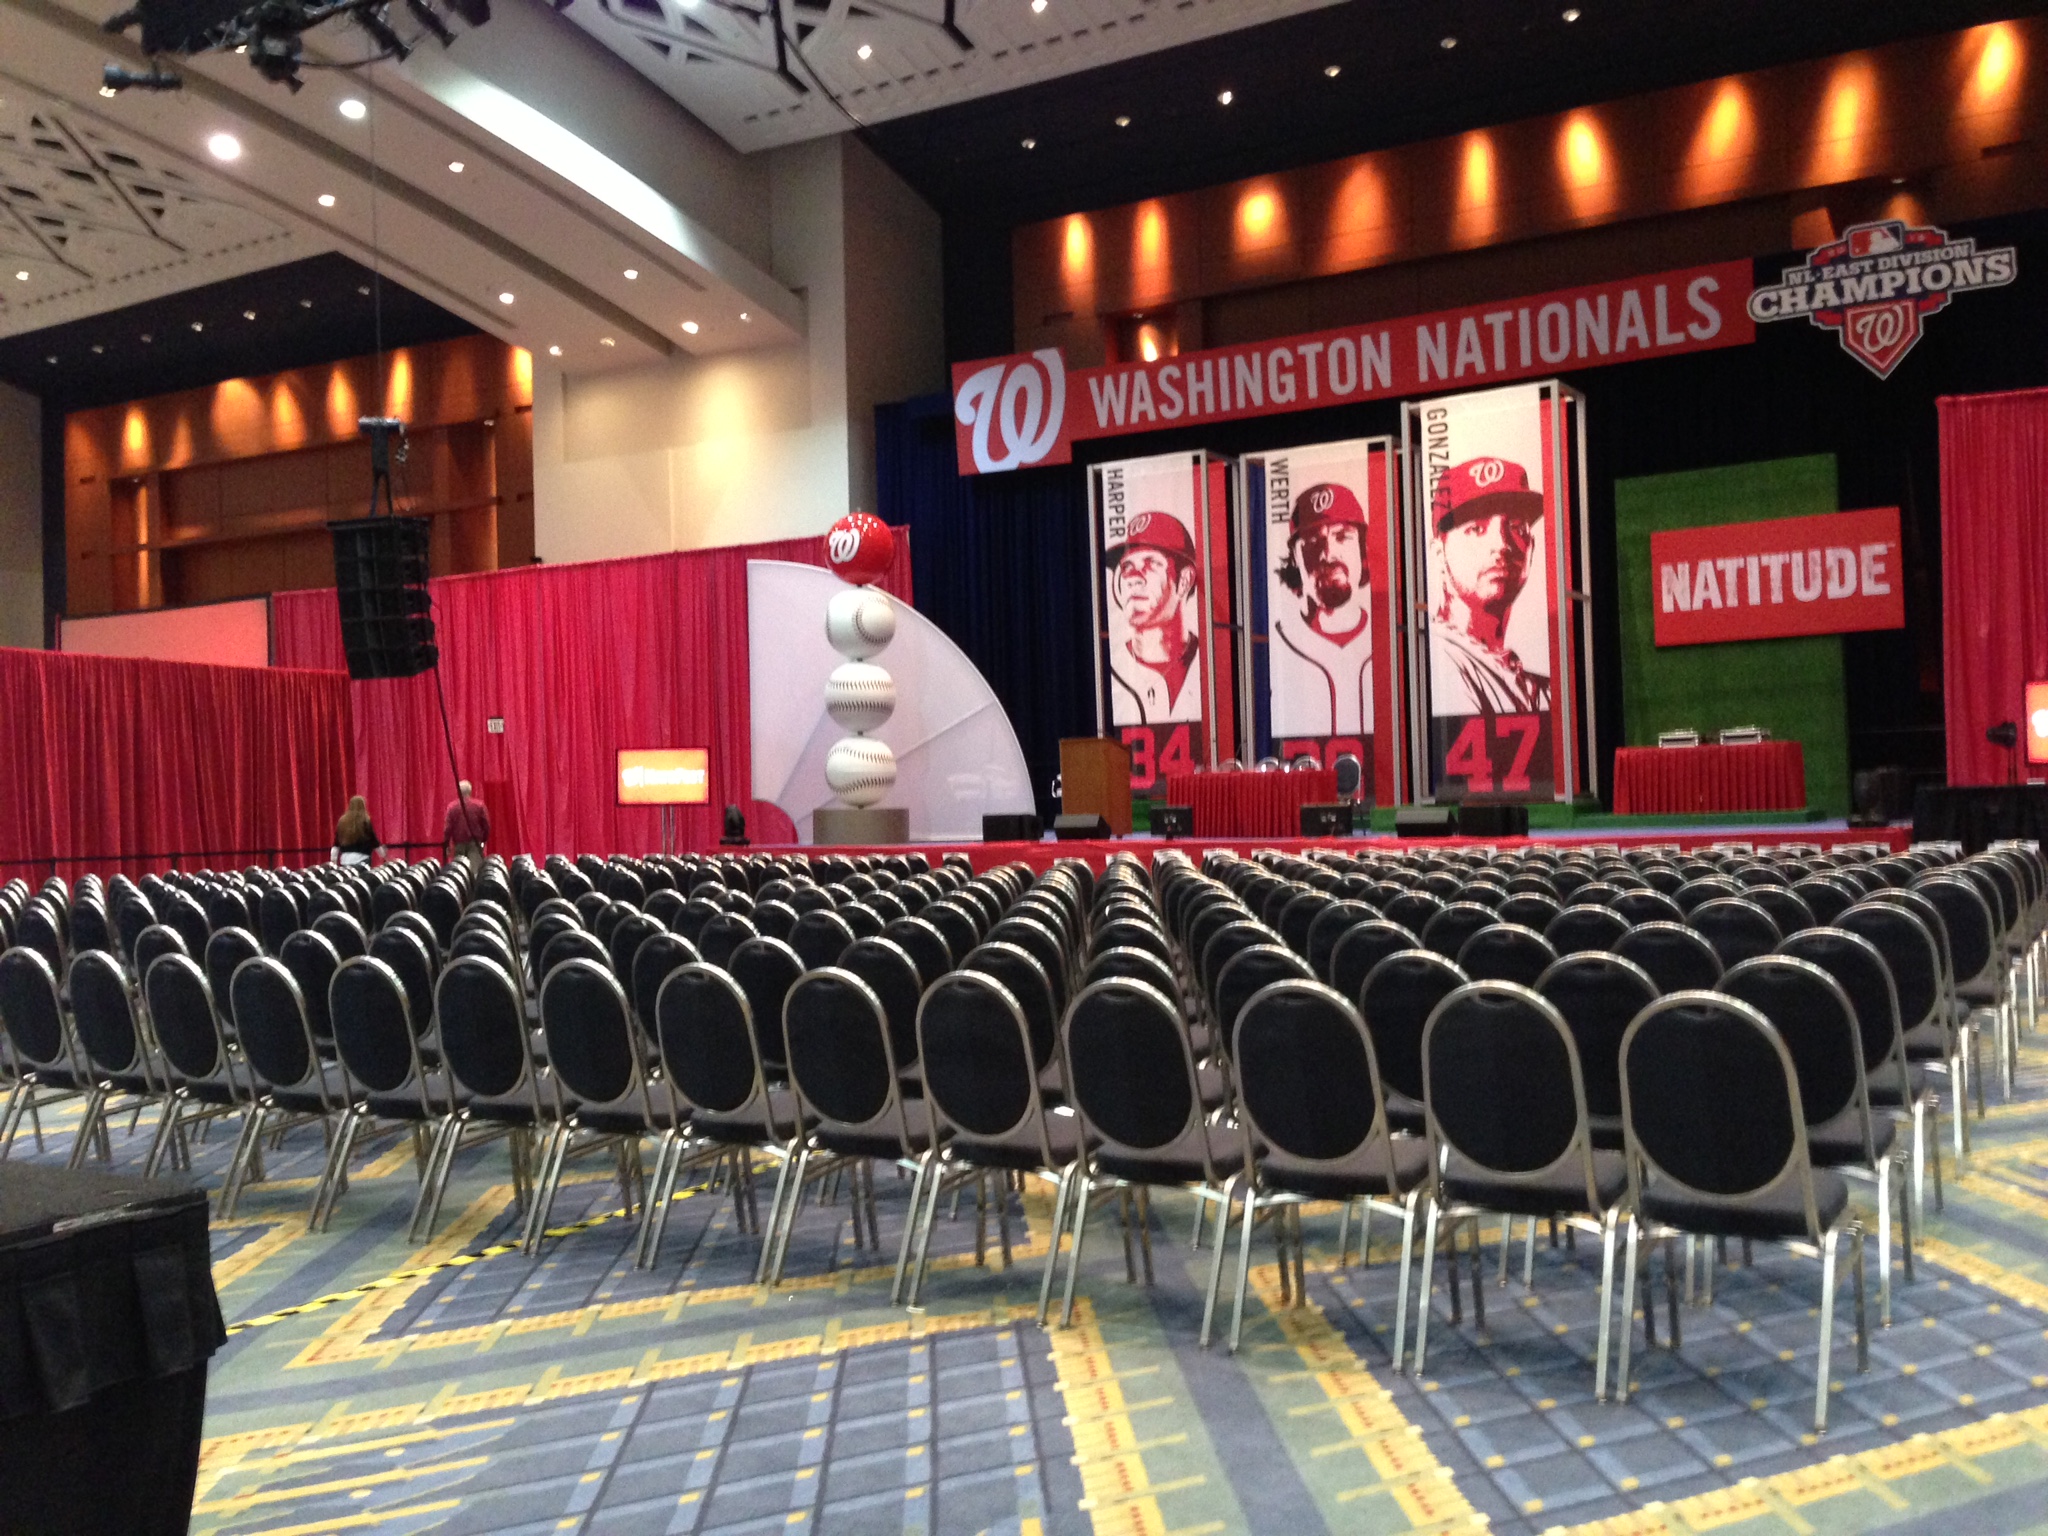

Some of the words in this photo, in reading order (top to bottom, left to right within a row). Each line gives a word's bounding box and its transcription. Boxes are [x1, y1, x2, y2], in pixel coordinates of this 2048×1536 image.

[1752, 253, 2012, 318] CHAMPIONS
[1878, 244, 1970, 270] DIVISION
[1088, 331, 1393, 429] WASHINGTON
[1416, 276, 1722, 384] NATIONALS
[955, 348, 1066, 474] W
[1270, 458, 1289, 524] WERTH
[1427, 407, 1452, 511] GONZALEZ
[1107, 468, 1126, 538] HARPER
[1661, 543, 1891, 613] NATITUDE
[1122, 724, 1194, 789] 34
[1445, 715, 1541, 792] 47
